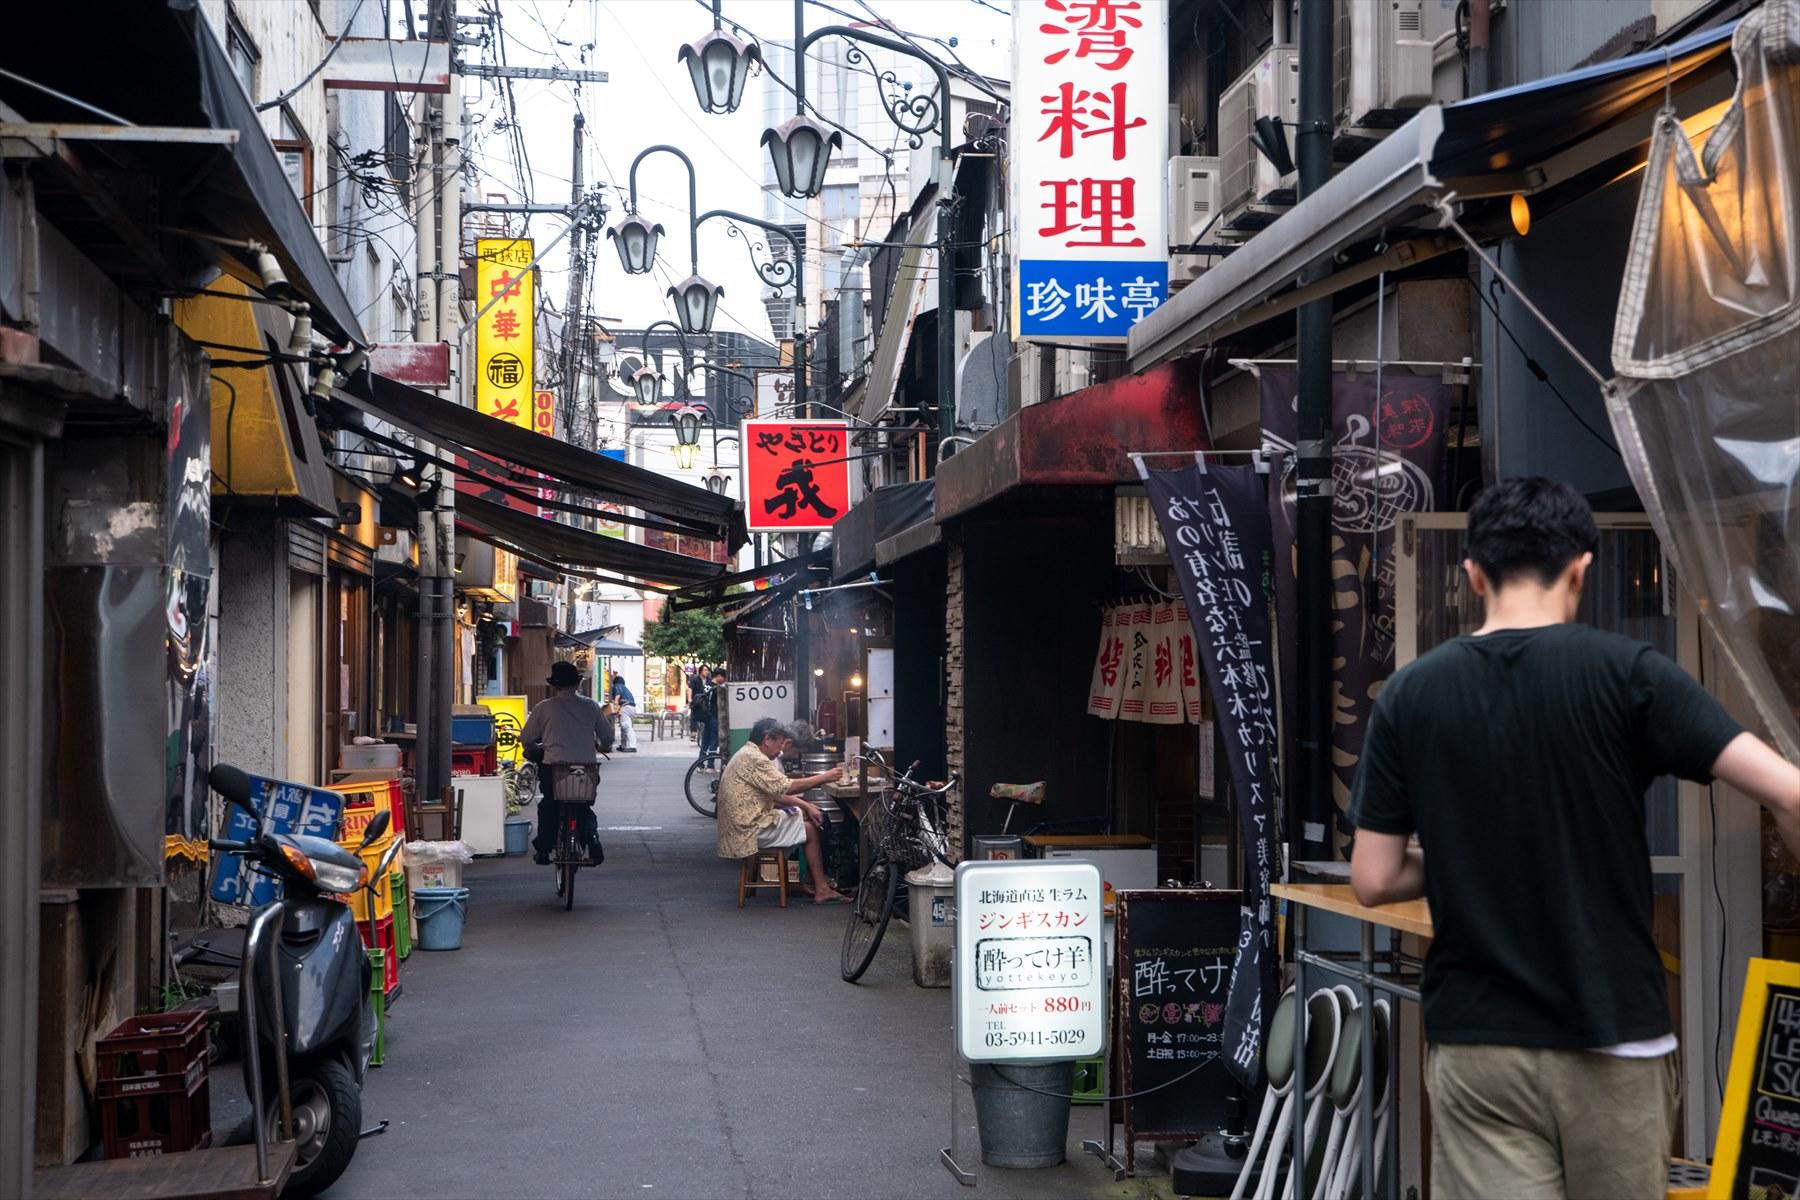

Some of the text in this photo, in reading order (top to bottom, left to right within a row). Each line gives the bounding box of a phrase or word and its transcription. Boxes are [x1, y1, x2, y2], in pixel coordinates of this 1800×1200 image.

[1026, 276, 1161, 323] 珍味亭
[756, 432, 839, 456] やきとり
[735, 685, 788, 702] 5000
[979, 888, 1088, 904] 北海道直送 生ラム
[979, 911, 1089, 930] ジンギスカン
[983, 946, 1085, 972] 酔ってけ羊
[985, 972, 1079, 986] yottekeyo
[1135, 957, 1229, 998] 酔ってけ
[985, 1021, 1006, 1031] TEL
[985, 1029, 1086, 1047] 03-5941-5029
[1755, 1097, 1800, 1128] Quee
